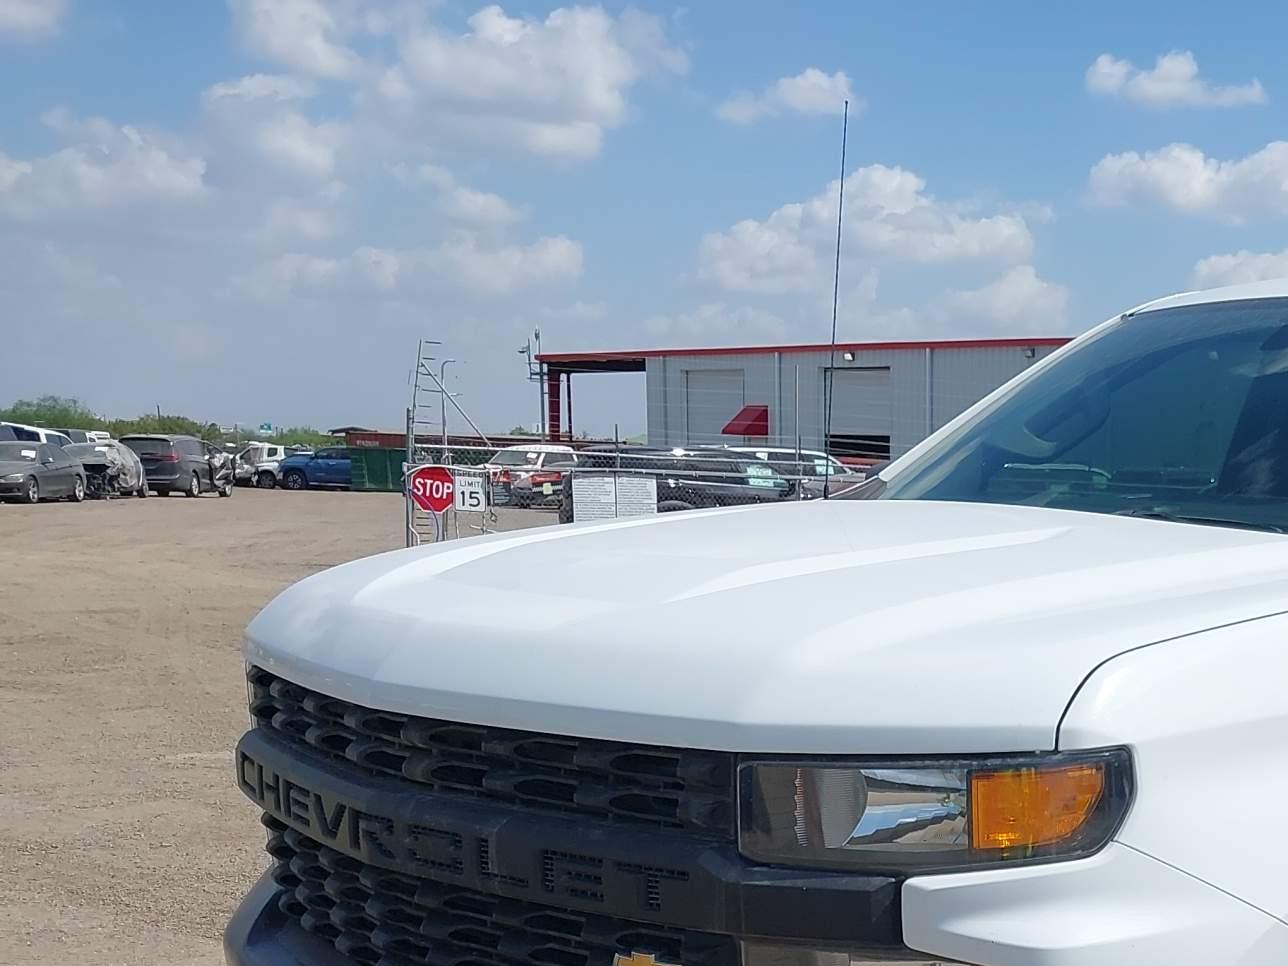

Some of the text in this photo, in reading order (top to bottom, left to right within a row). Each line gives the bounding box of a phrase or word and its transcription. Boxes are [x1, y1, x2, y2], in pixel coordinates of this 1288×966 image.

[415, 478, 453, 499] STOP
[460, 480, 481, 488] LIMIT
[461, 490, 481, 507] 15
[239, 750, 690, 912] CHEVROLET
